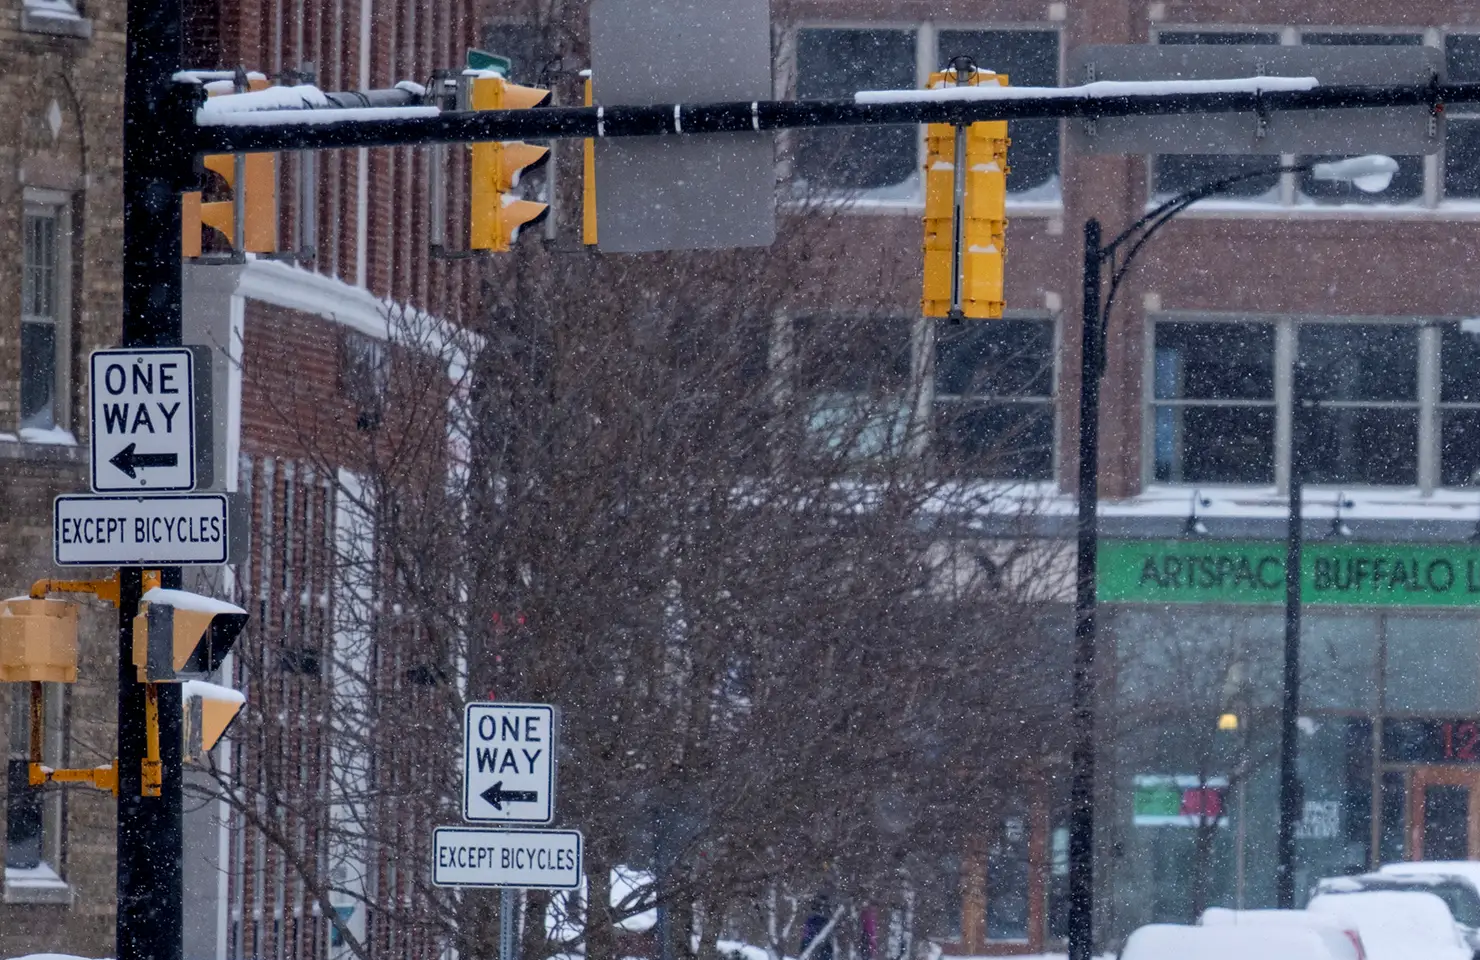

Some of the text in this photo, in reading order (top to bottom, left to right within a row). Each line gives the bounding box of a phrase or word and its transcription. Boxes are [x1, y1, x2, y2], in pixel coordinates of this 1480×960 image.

[105, 363, 179, 395] ONE
[103, 402, 181, 434] WAY
[62, 516, 220, 544] EXCEPT BICYCLES
[1139, 555, 1282, 590] ARTSPAC
[1313, 557, 1454, 593] BUFFALO
[478, 714, 541, 742] ONE
[476, 747, 542, 774] WAY
[439, 846, 574, 871] EXCEPT BICYCLES
